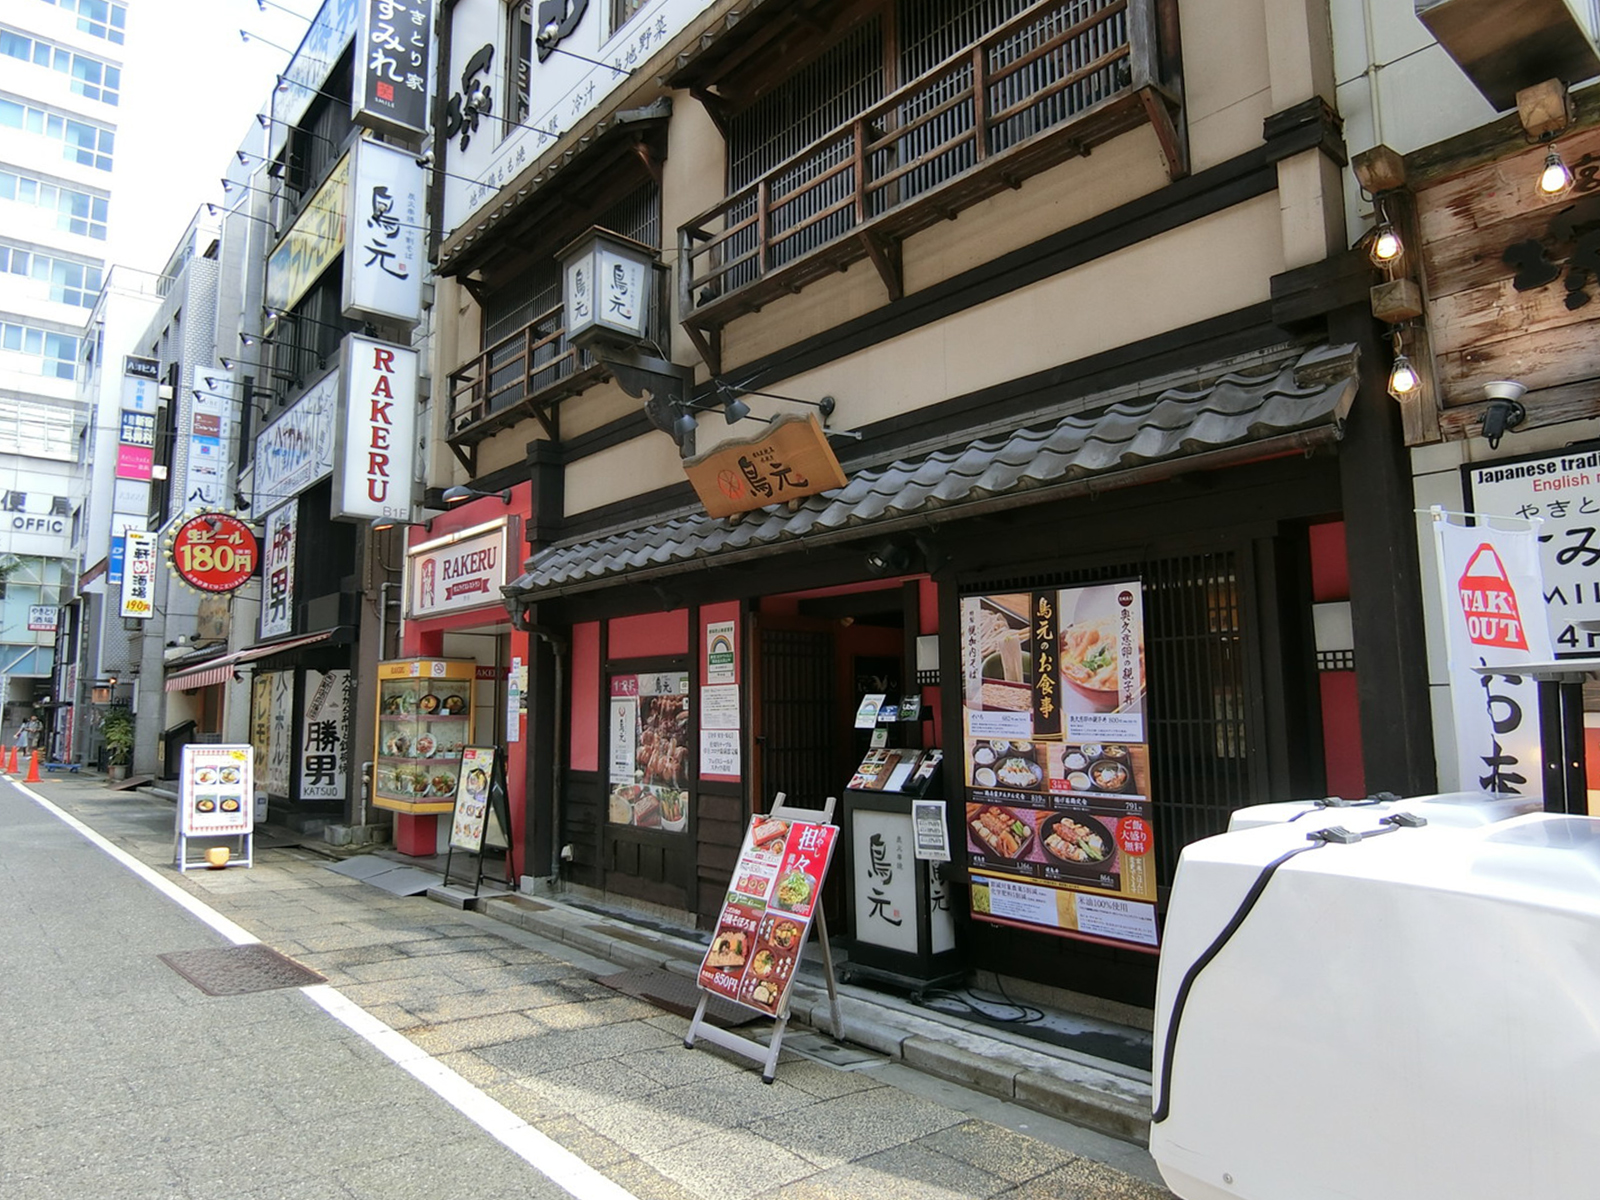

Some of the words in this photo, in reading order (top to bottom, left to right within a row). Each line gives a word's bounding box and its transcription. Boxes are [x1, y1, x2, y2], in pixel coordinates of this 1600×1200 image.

[405, 0, 426, 92] きとり家
[364, 186, 408, 281] 鳥元
[609, 264, 632, 320] 鳥元
[367, 348, 395, 502] RAKERU
[738, 455, 809, 498] 鳥元
[1478, 458, 1557, 484] Japanese
[1532, 473, 1590, 492] English
[383, 506, 407, 518] B1F
[187, 529, 244, 545] 生ビール
[1538, 527, 1600, 567] み
[181, 545, 252, 573] 180円
[442, 546, 498, 581] RAKERU
[31, 607, 57, 617] やきとり
[125, 600, 151, 612] 190円
[1469, 616, 1520, 643] OUT
[1036, 596, 1055, 718] 鳥元のお食事
[304, 720, 341, 786] 勝男
[304, 786, 337, 797] KATSUO
[1120, 830, 1147, 842] 大盛り
[1123, 820, 1143, 831] ご飯
[794, 826, 820, 875] 担々
[813, 826, 829, 858] 冷やし
[1124, 841, 1144, 853] 無料
[867, 833, 902, 926] 鳥元
[713, 971, 739, 993] 850円
